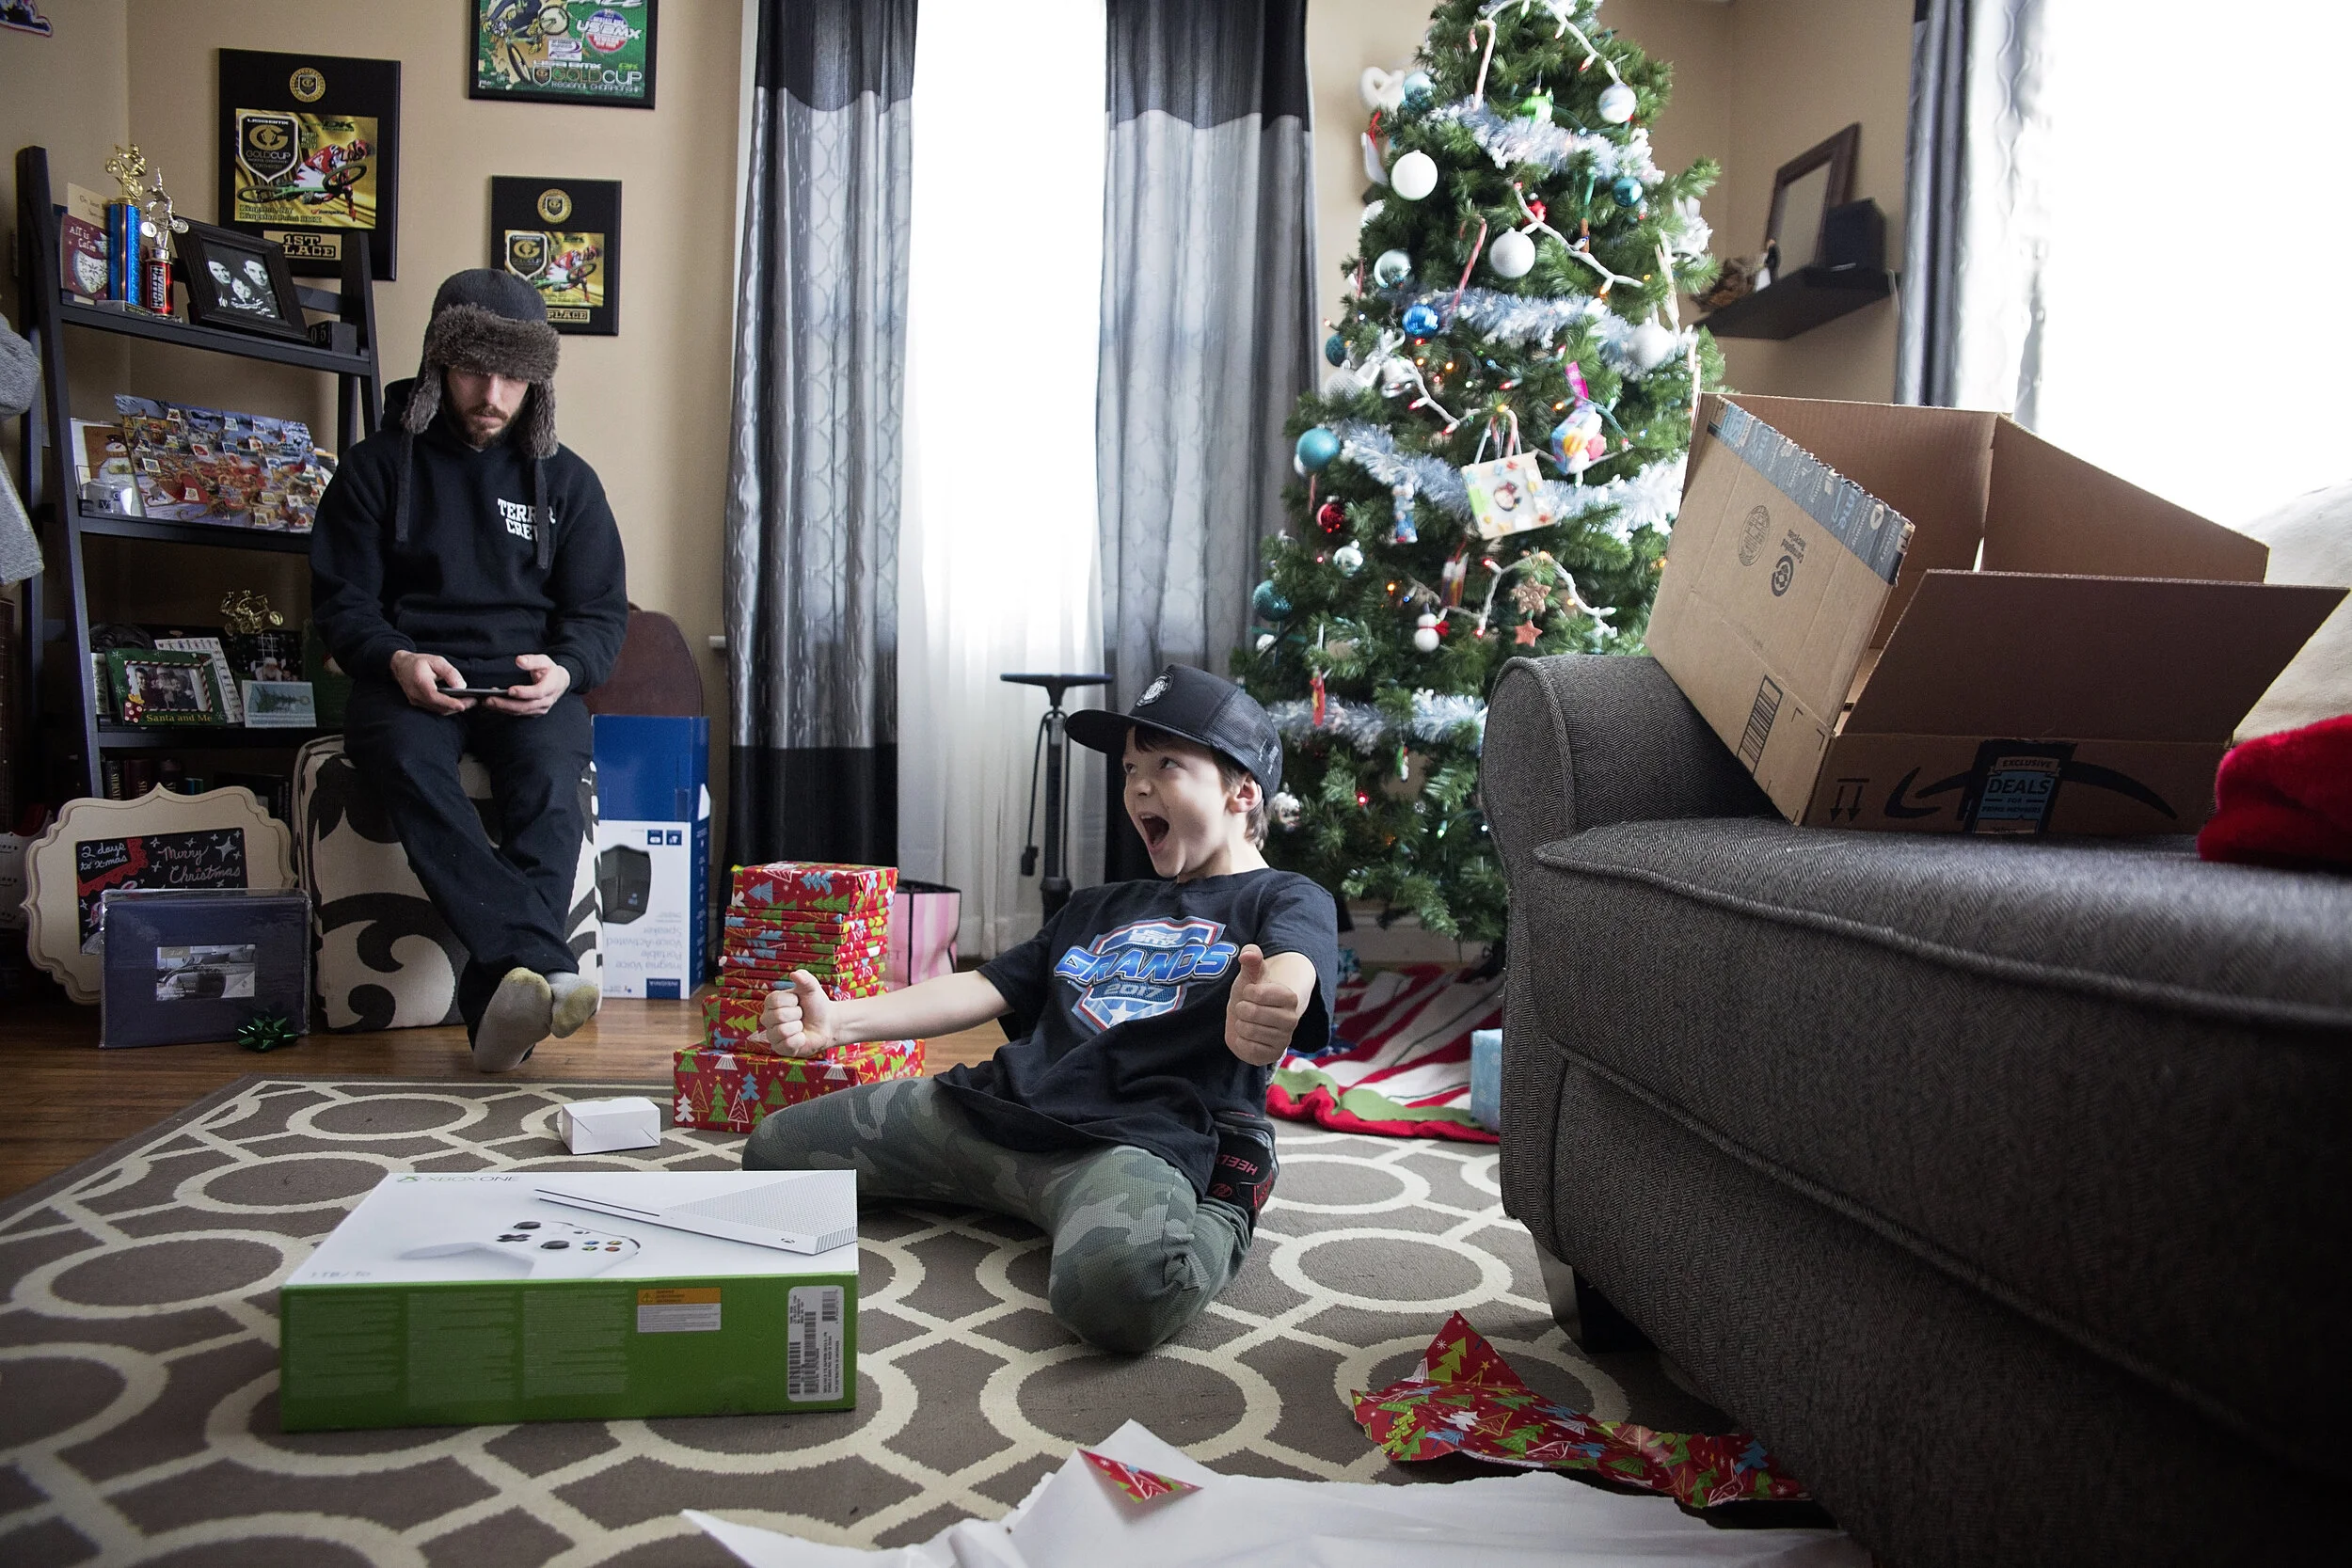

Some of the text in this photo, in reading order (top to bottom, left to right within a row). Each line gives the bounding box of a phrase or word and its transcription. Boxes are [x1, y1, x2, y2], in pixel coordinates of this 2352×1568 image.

[284, 236, 320, 245] 1ST
[283, 245, 335, 257] LACE
[147, 714, 213, 722] Santa and Me
[2002, 759, 2053, 768] EXCLUSIVE
[1987, 778, 2051, 795] DEALS
[82, 842, 127, 858] 2 days
[158, 846, 209, 865] Merry
[169, 864, 241, 884] Christmas
[1054, 943, 1238, 983] GRANDS
[1104, 983, 1165, 999] 2017
